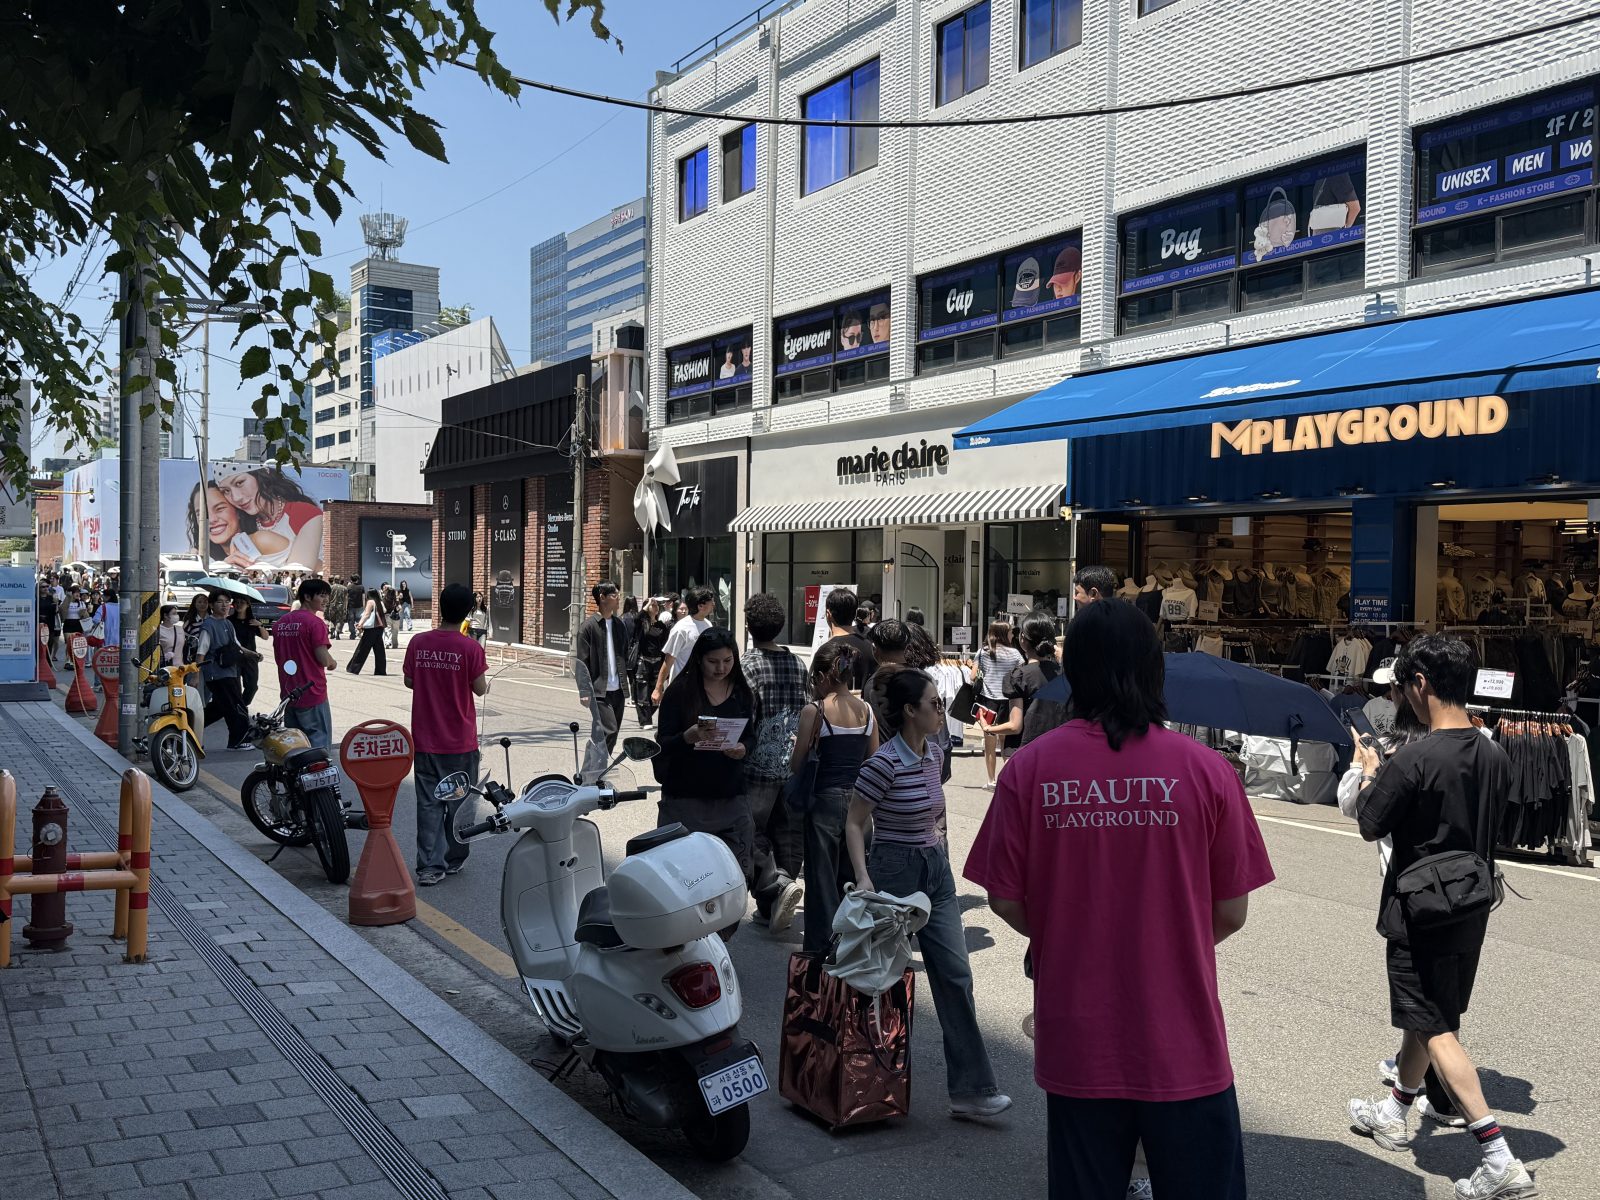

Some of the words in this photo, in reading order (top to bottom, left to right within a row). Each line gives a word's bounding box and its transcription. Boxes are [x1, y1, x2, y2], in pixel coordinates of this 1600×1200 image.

[1545, 114, 1566, 138] 1F
[1512, 152, 1545, 175] MEN
[1441, 165, 1492, 192] UNISEX
[1526, 181, 1555, 194] STORE
[1160, 227, 1202, 260] Bag
[946, 288, 974, 317] Cap
[783, 329, 832, 360] Eyewear
[673, 357, 709, 383] FASHION
[837, 445, 891, 477] marie
[891, 438, 949, 471] claire
[876, 471, 906, 487] PARIS
[448, 530, 467, 541] STUDIO
[494, 529, 517, 541] S-CLASS
[1354, 598, 1371, 606] PLAY
[277, 622, 301, 632] BEAUTY
[99, 655, 119, 664] 주차금
[415, 661, 461, 672] PLAYGROUND
[416, 650, 462, 664] BEAUTY
[353, 738, 404, 758] 주차금지
[313, 773, 337, 787] 7577
[1040, 777, 1179, 807] BEAUTY
[1043, 810, 1179, 829] PLAYGROUND
[722, 1073, 763, 1102] 0500
